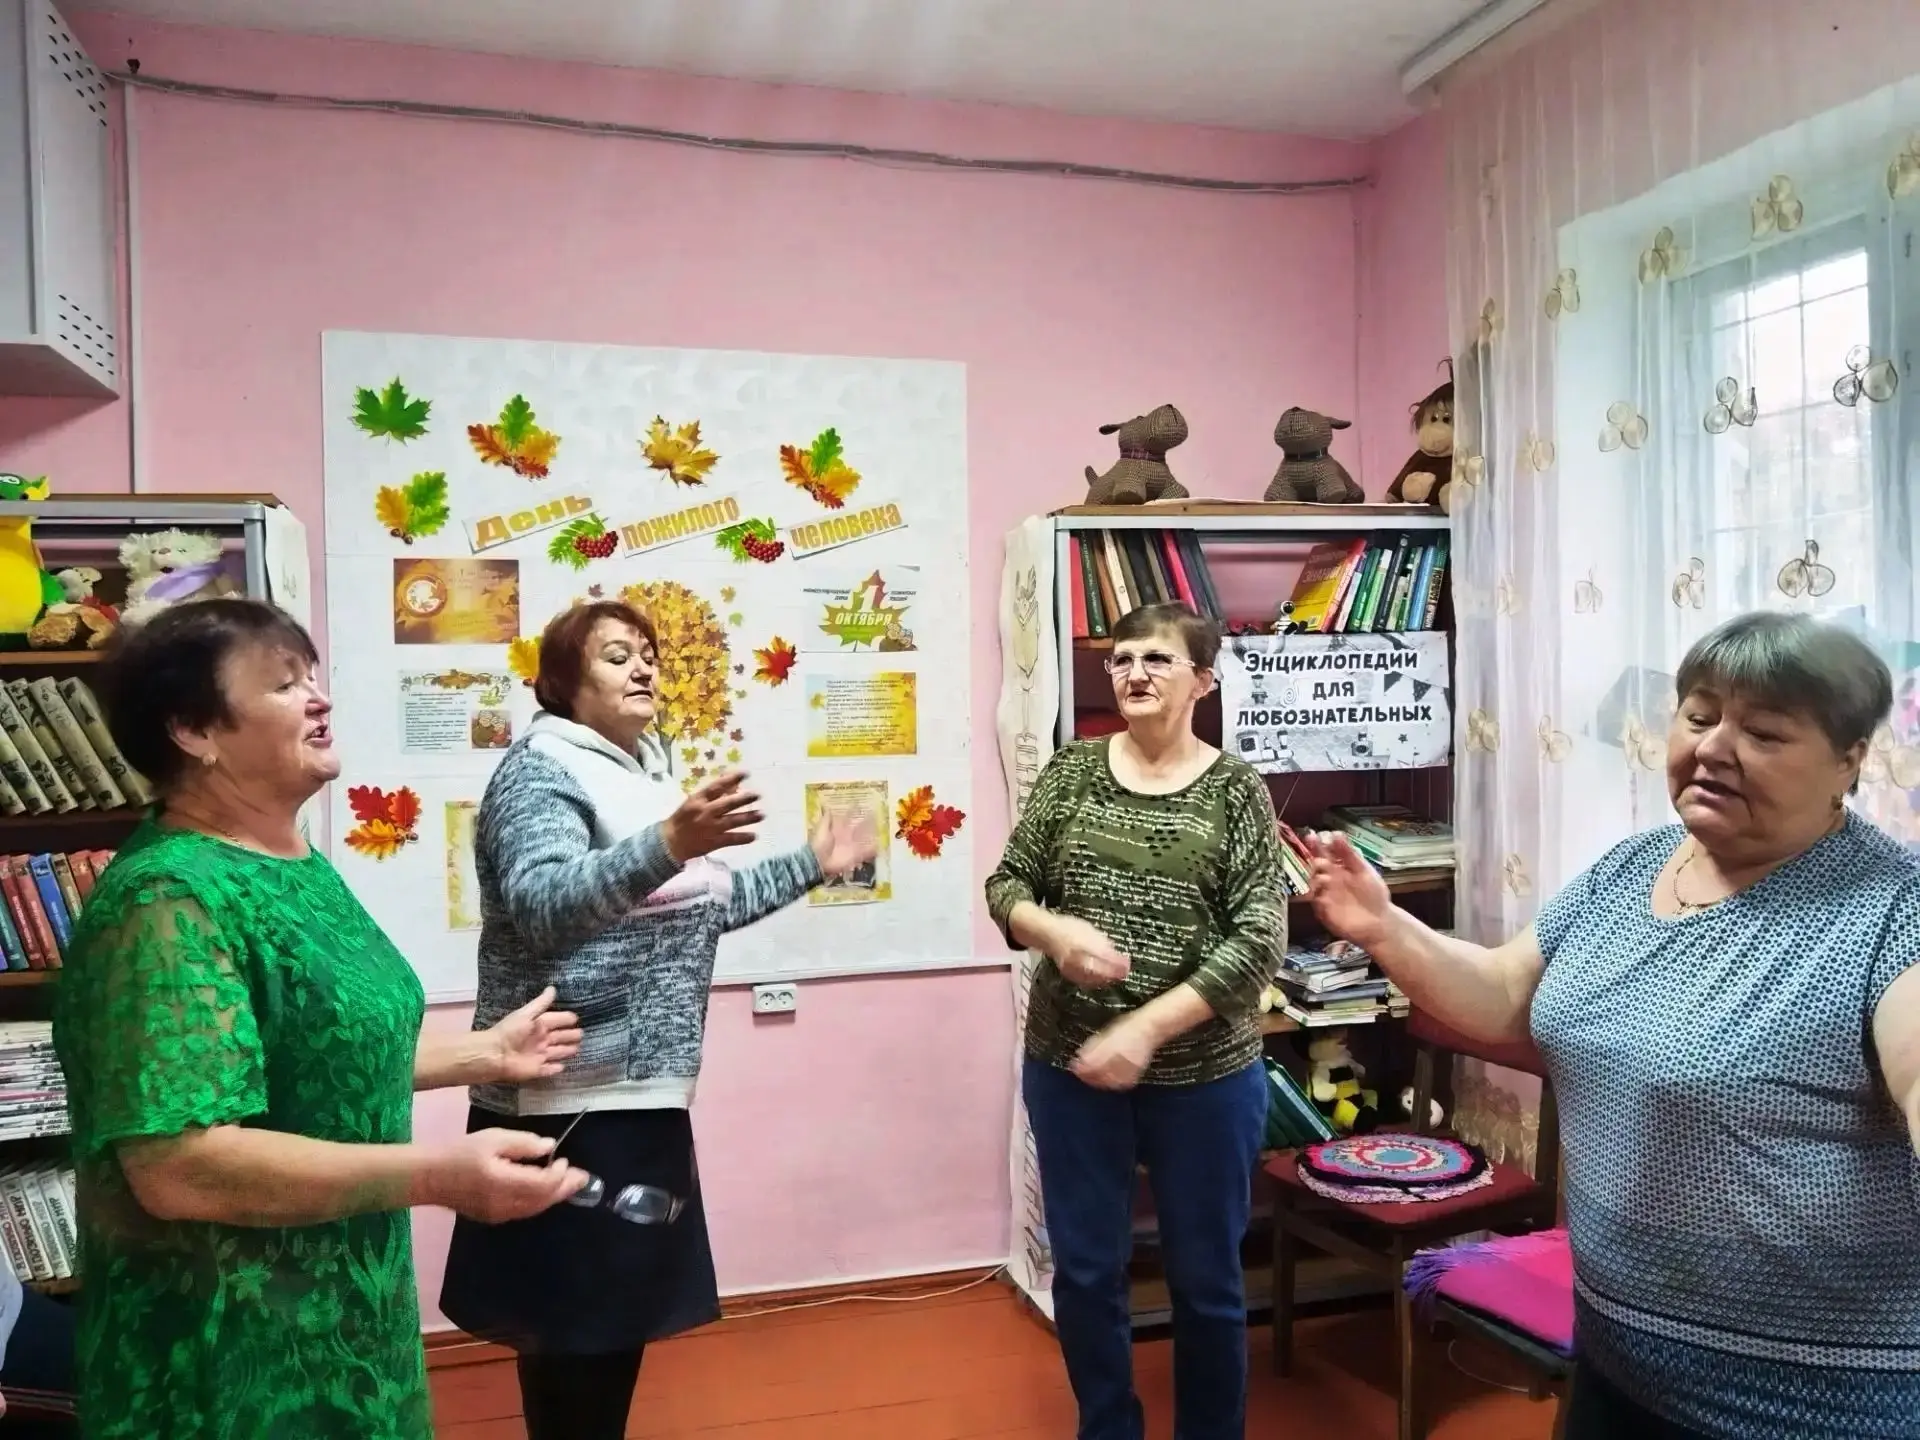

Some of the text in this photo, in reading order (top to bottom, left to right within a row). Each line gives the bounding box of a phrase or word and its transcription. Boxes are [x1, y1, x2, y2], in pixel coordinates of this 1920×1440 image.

[475, 495, 592, 548] День
[790, 503, 902, 549] человека
[858, 585, 880, 612] 1
[835, 612, 893, 625] ОКТЯБРЯ
[1245, 652, 1418, 673] ЭНЦИКЛОПЕДИИ
[1312, 681, 1355, 701] ДЛЯ
[1236, 705, 1432, 726] ЛЮБОЗНАТЕЛЬНЫХ
[10, 1195, 27, 1217] МИР
[49, 1197, 65, 1218] МИР
[20, 1219, 43, 1264] ПОЗНАЮ
